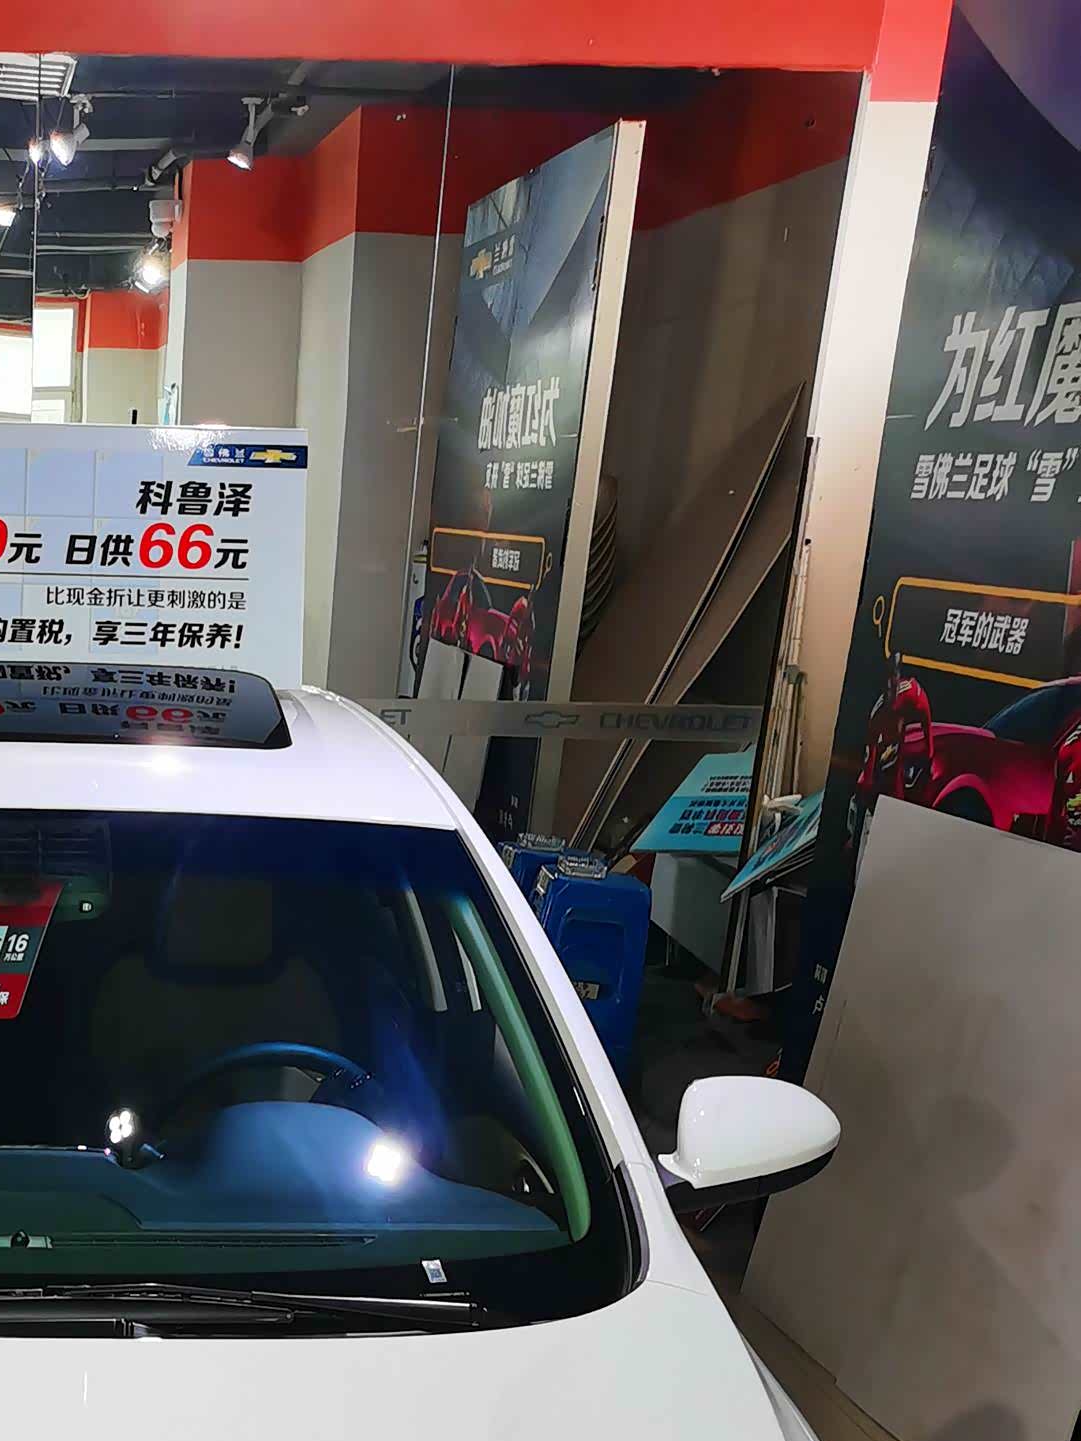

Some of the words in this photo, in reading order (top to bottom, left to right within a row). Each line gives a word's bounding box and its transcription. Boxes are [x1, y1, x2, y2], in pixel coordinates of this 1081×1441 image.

[924, 302, 1081, 431] 为红魔
[910, 448, 1081, 502] 雪佛兰足球“雪”
[136, 481, 252, 517] 科鲁泽
[65, 522, 249, 569] 日供66元
[46, 586, 247, 610] 比现金折让更刺激的是
[940, 608, 1029, 655] 冠军的武器
[380, 709, 412, 725] ET
[600, 712, 752, 729] CHEVROLET
[7, 934, 29, 953] 16
